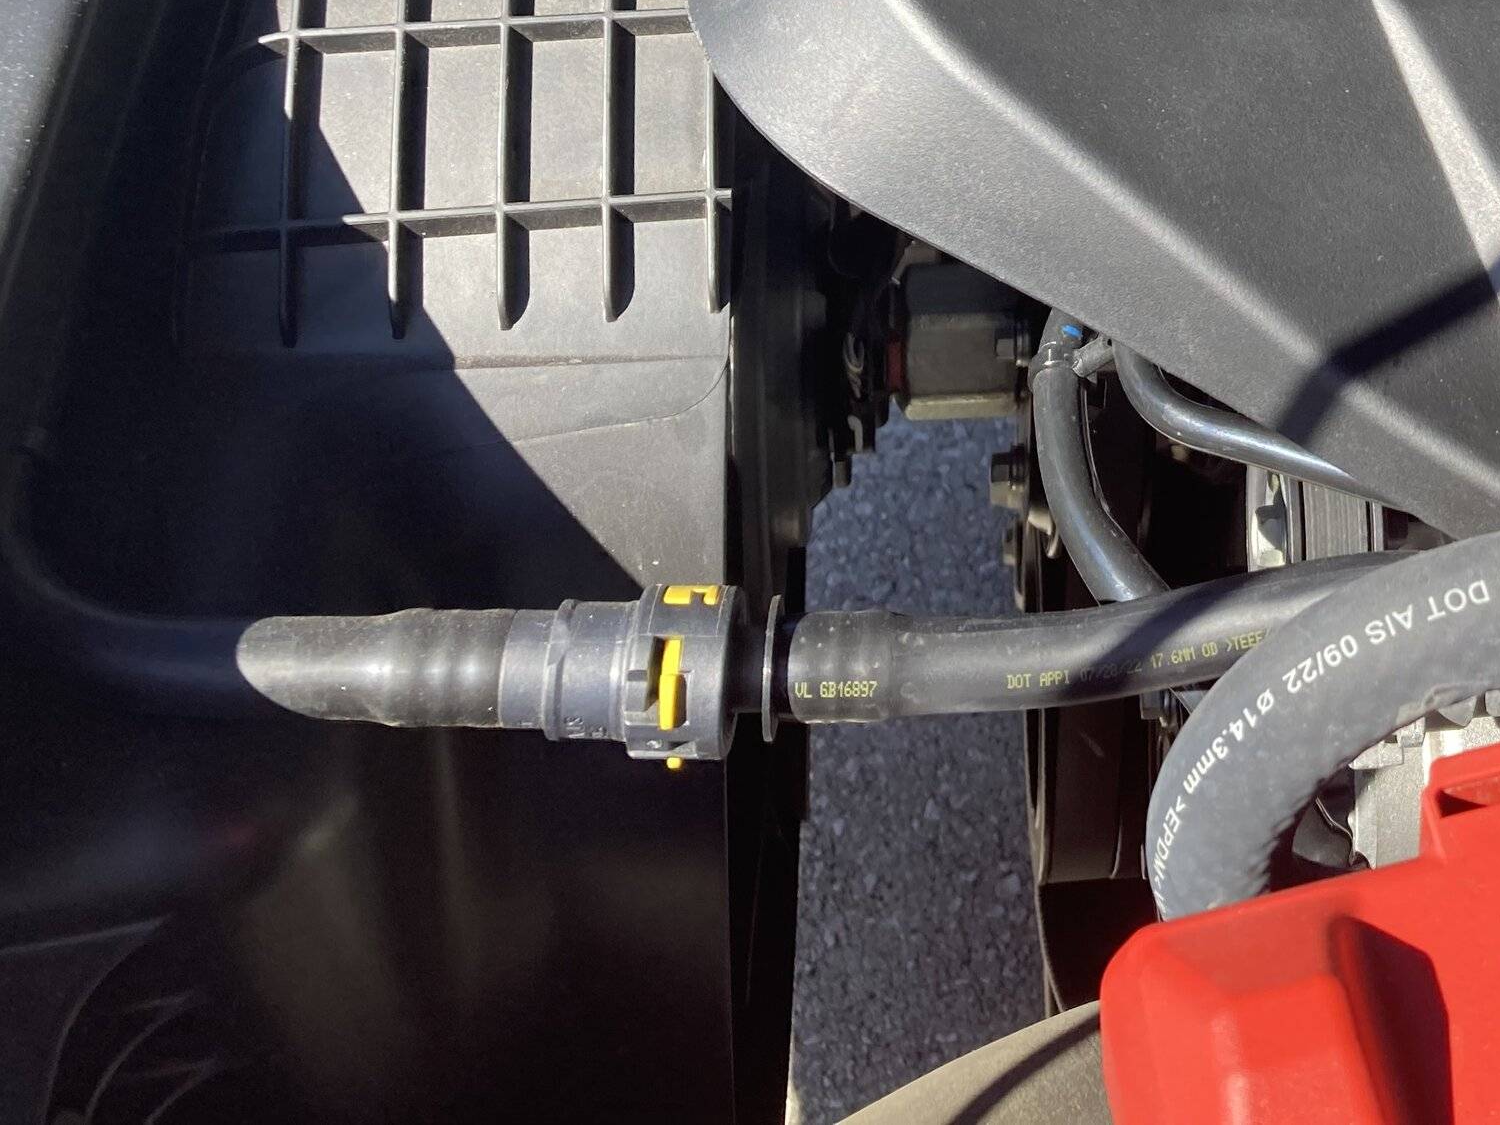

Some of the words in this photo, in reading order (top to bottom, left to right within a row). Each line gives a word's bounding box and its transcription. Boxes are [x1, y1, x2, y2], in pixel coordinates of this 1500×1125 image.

[1426, 579, 1491, 622] DOT
[1006, 672, 1033, 690] DOT
[1039, 669, 1071, 688] APPI
[1281, 634, 1360, 695] 09/22
[819, 680, 879, 699] GB16897
